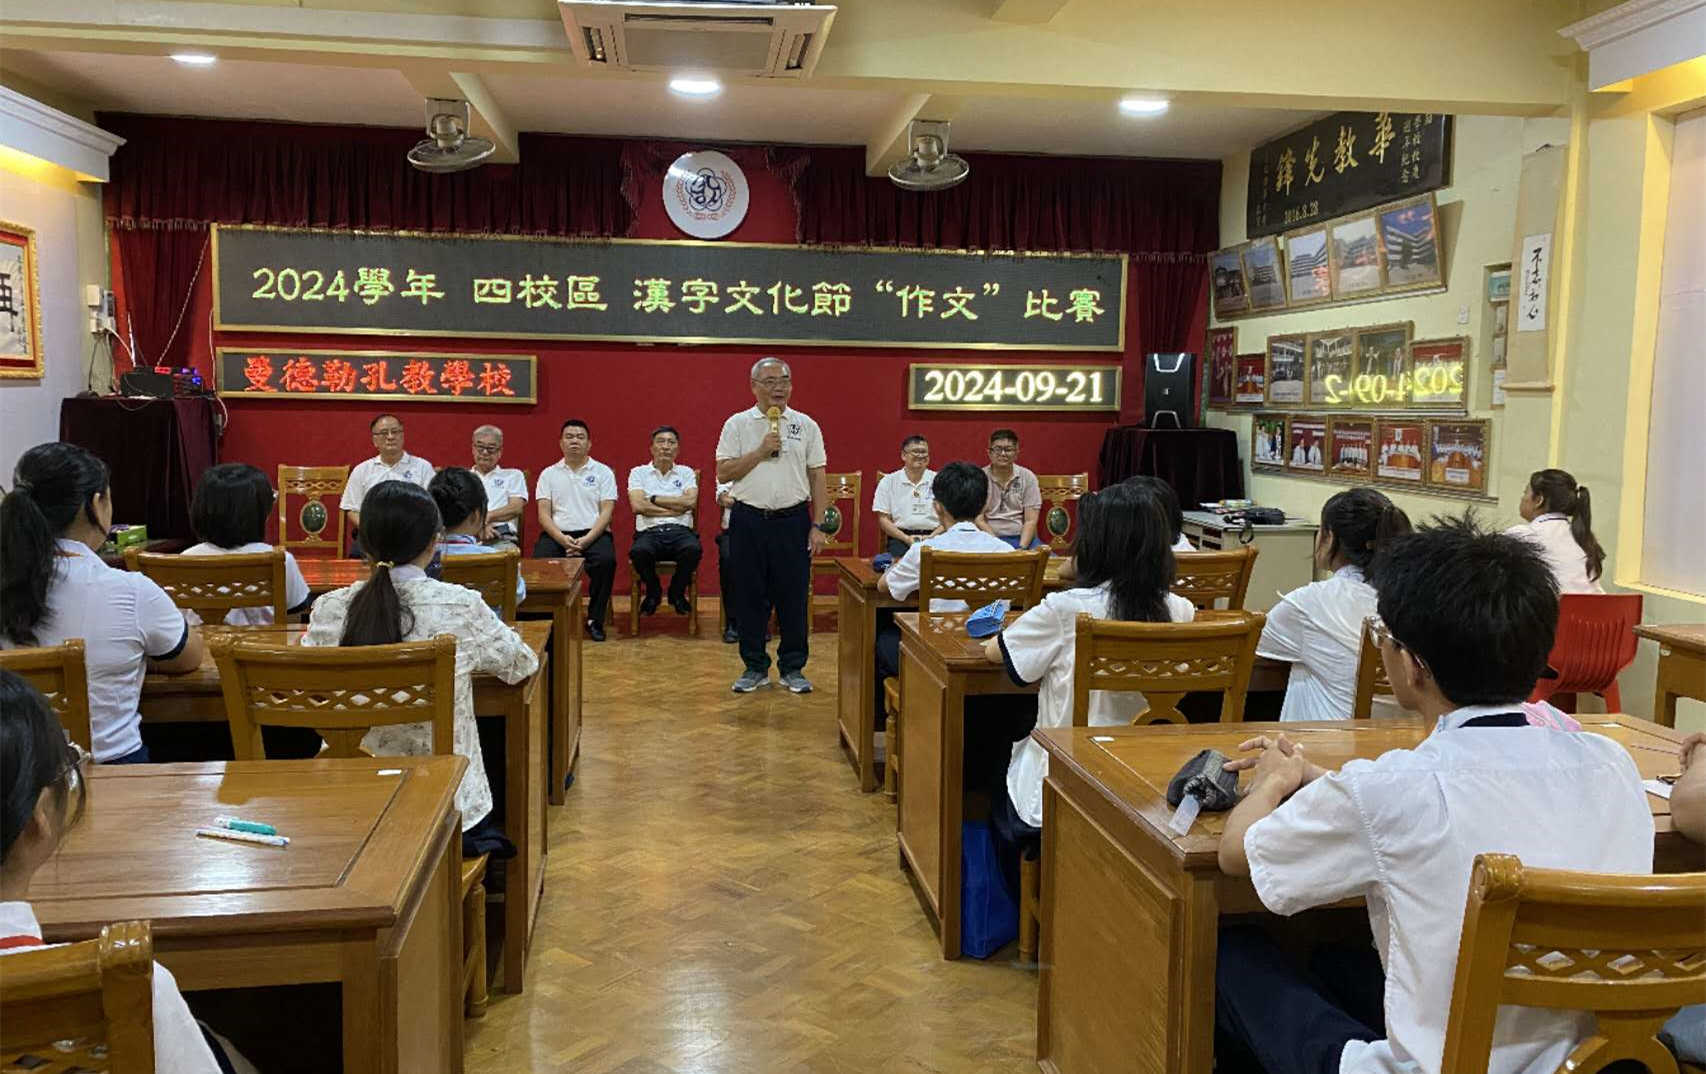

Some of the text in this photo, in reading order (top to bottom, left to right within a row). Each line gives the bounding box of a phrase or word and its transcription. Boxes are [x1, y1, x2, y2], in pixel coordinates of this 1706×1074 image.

[251, 266, 446, 306] 2024學年
[473, 273, 609, 312] 四校區
[632, 277, 853, 318] 漢字文化節
[1023, 287, 1105, 323] 比賽
[243, 354, 516, 397] 曼德勒孔教學校
[922, 369, 1104, 403] 2024-09-21
